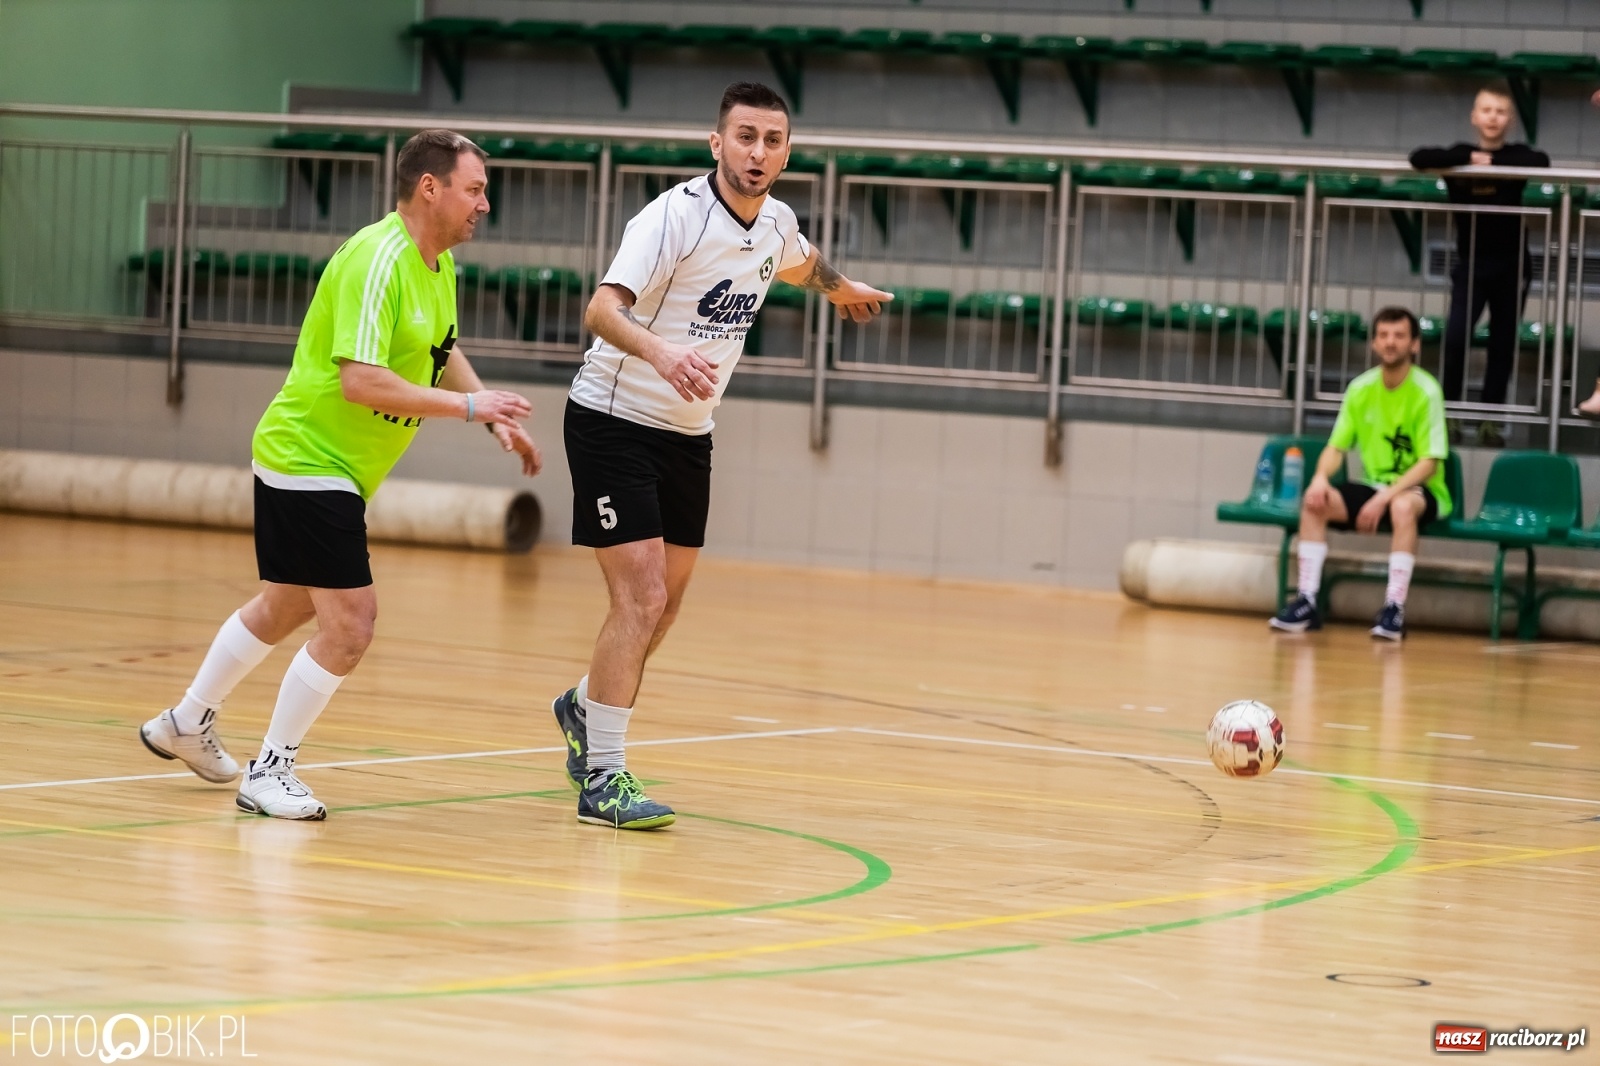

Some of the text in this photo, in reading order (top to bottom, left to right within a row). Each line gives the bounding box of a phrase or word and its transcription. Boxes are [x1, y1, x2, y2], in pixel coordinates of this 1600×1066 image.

[708, 310, 757, 324] KANTO
[597, 495, 618, 530] 5
[249, 770, 265, 781] PUMA
